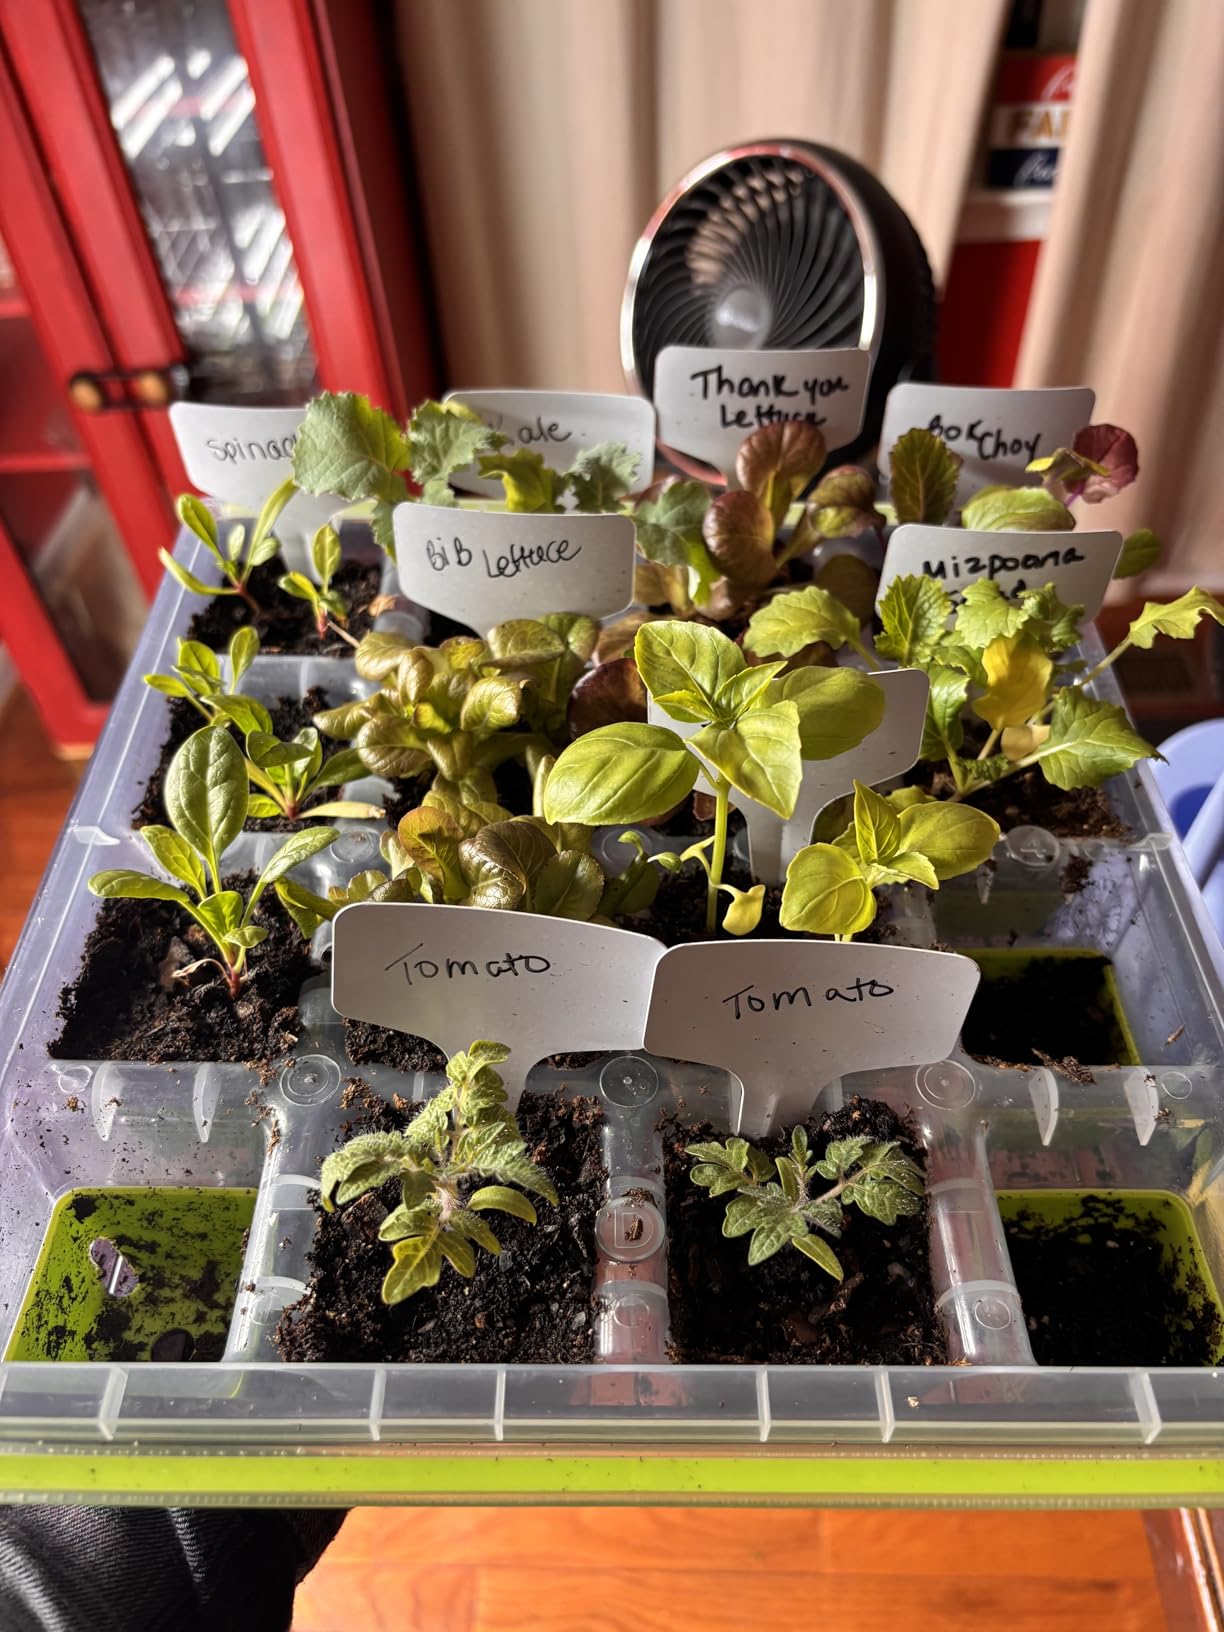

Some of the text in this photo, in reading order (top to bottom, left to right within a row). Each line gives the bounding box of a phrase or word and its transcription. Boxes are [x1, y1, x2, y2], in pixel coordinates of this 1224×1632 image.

[690, 364, 849, 405] Thank you
[207, 433, 297, 464] Spinac
[976, 426, 1042, 462] Choy
[426, 537, 582, 578] BiB Lettuce
[384, 942, 551, 986] Tomato
[722, 977, 895, 1020] Tomato
